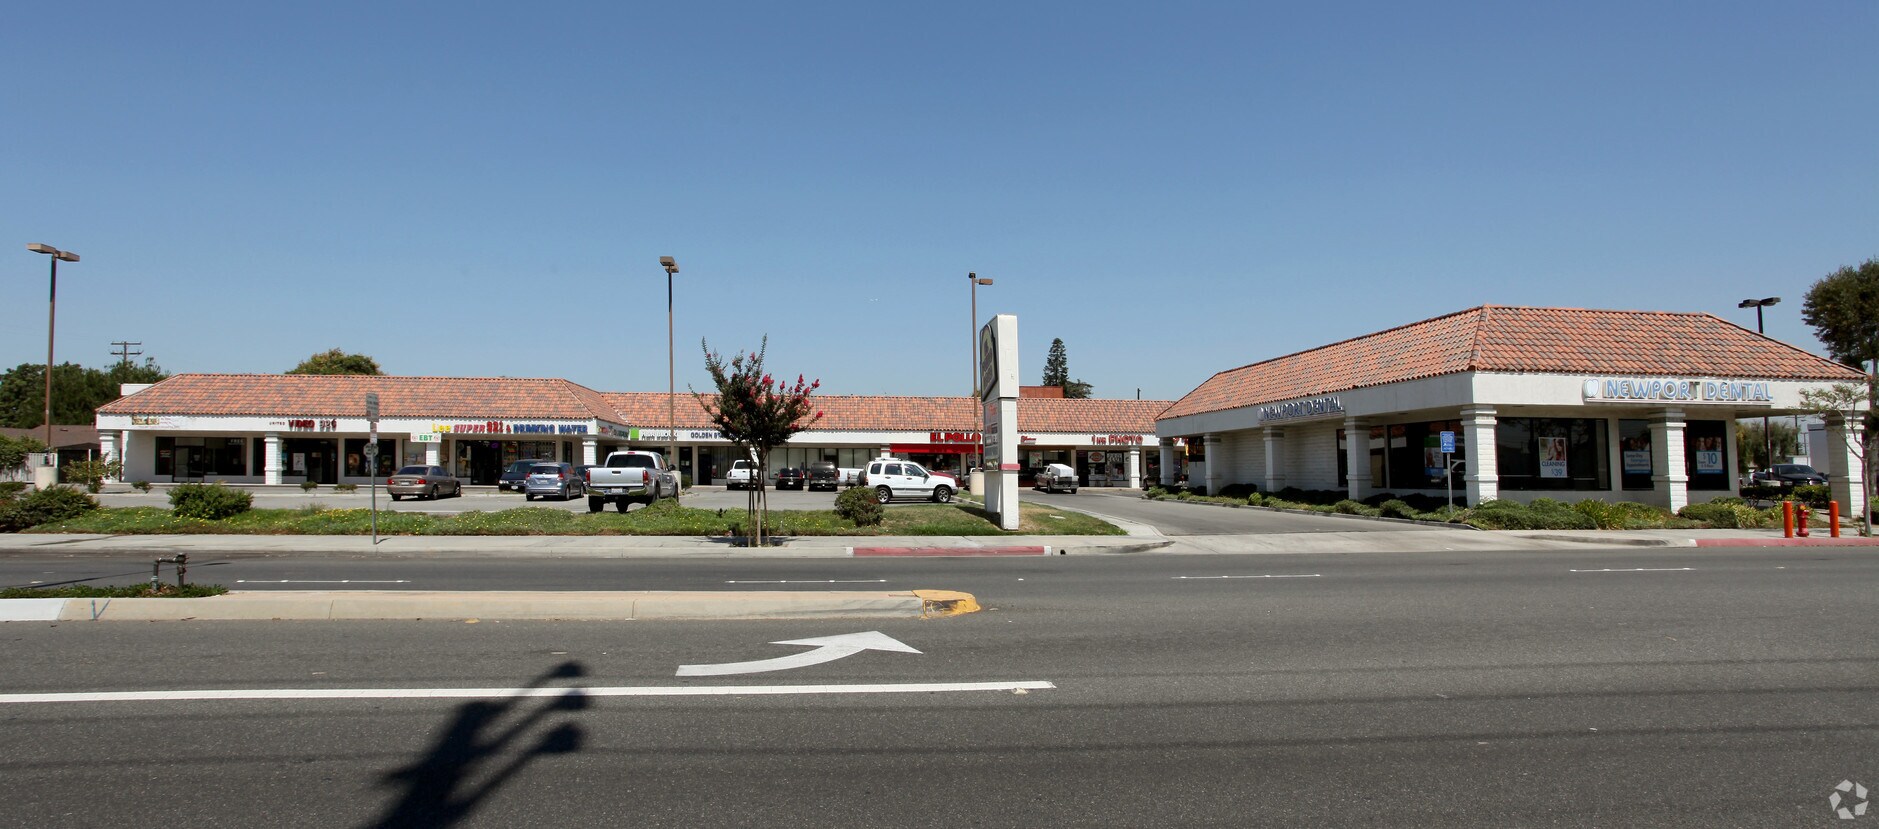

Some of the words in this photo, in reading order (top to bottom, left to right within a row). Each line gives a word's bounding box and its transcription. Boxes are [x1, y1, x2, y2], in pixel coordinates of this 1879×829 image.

[1606, 380, 1700, 399] NEWPORT
[1706, 381, 1773, 400] DENTAL
[1263, 402, 1304, 419] NEWPORT
[1306, 397, 1342, 414] DENTAL
[288, 419, 315, 429] VIDEO
[432, 422, 451, 432] Lee
[454, 424, 485, 433] SUPER
[513, 424, 555, 433] DRINKING
[559, 424, 588, 433] WATER
[690, 431, 713, 439] GOLDEN
[930, 432, 944, 443] EL
[945, 432, 981, 443] POLLO
[1109, 434, 1143, 444] PHOTO
[1703, 452, 1718, 465] $10
[1551, 468, 1563, 476] $39
